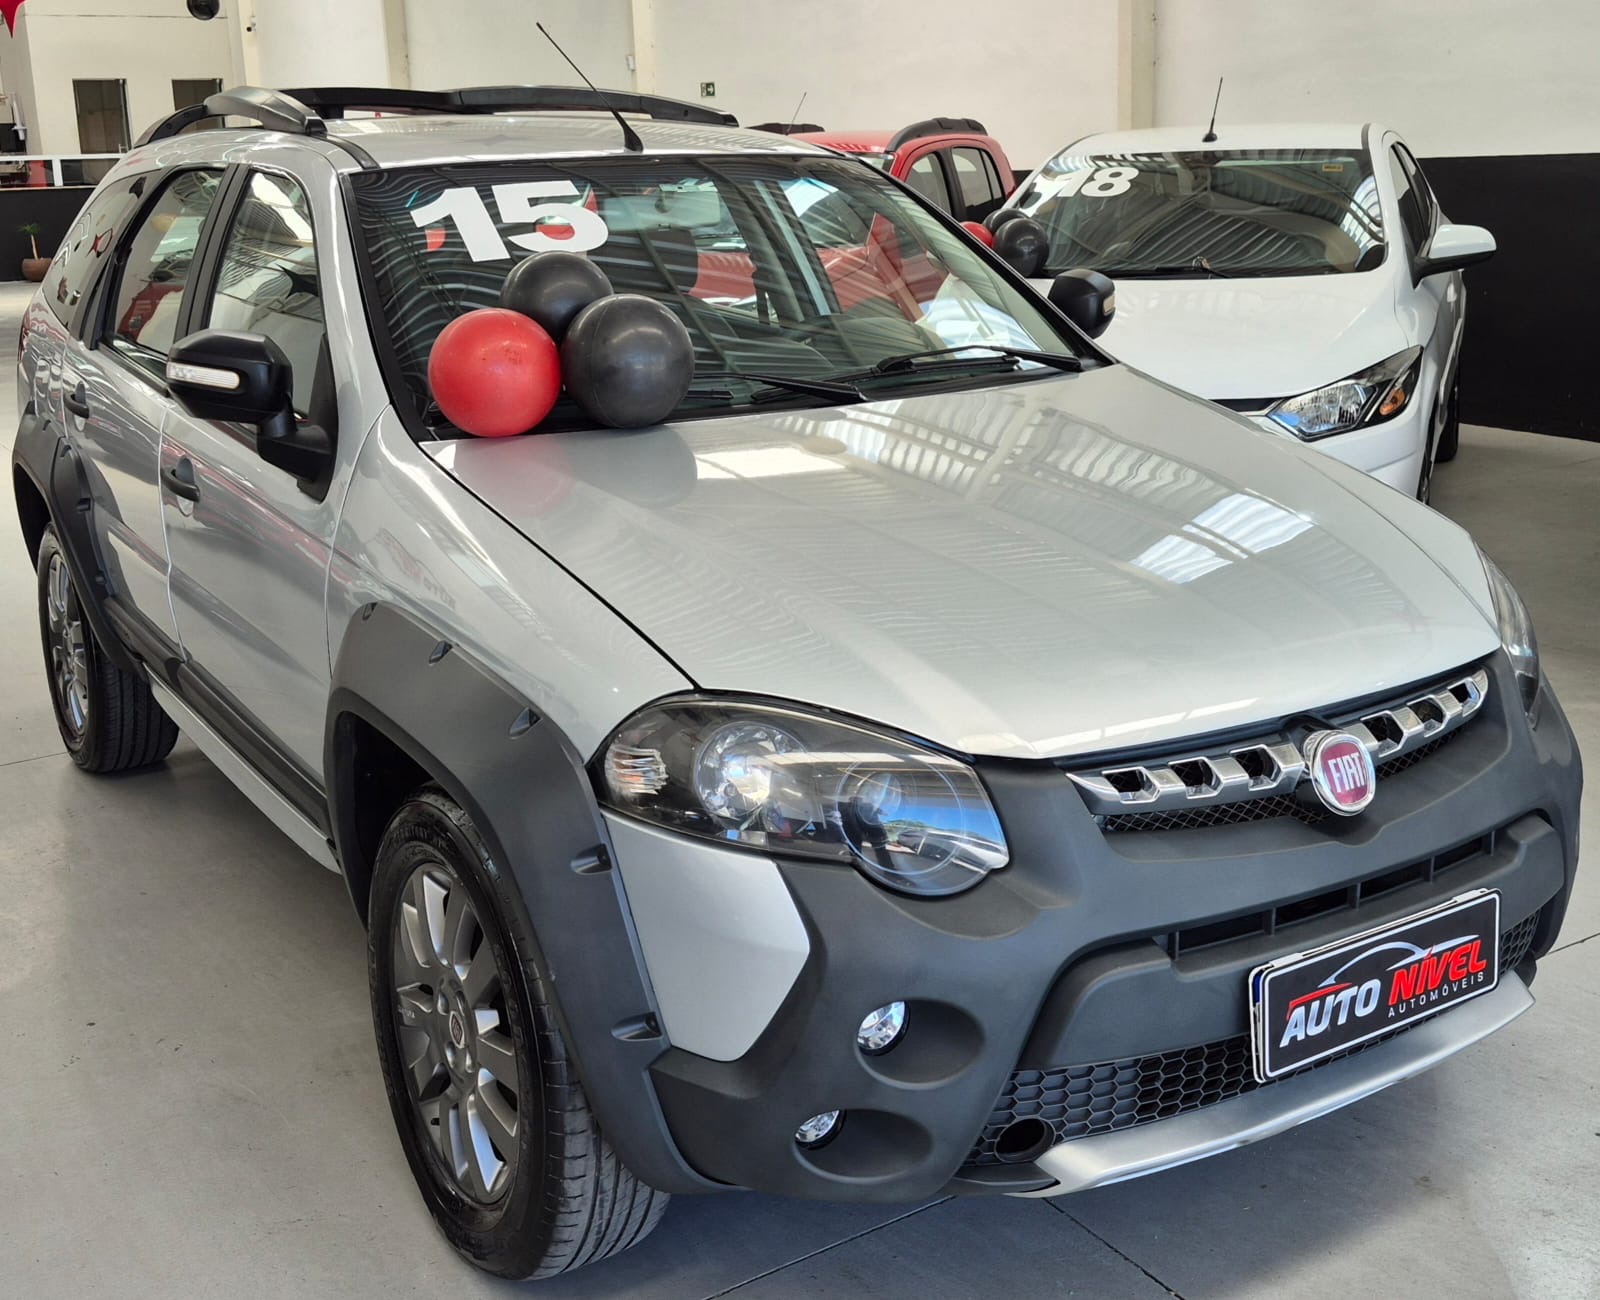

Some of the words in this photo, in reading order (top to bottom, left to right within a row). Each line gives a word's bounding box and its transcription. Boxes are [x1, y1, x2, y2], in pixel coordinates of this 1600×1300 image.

[1053, 166, 1140, 198] 18
[410, 180, 609, 262] 15
[1327, 752, 1365, 793] FIAT
[1279, 978, 1382, 1048] AUTO
[1387, 939, 1488, 1006] NÍVEL
[1387, 972, 1485, 1018] AUTOMÓVEIS
